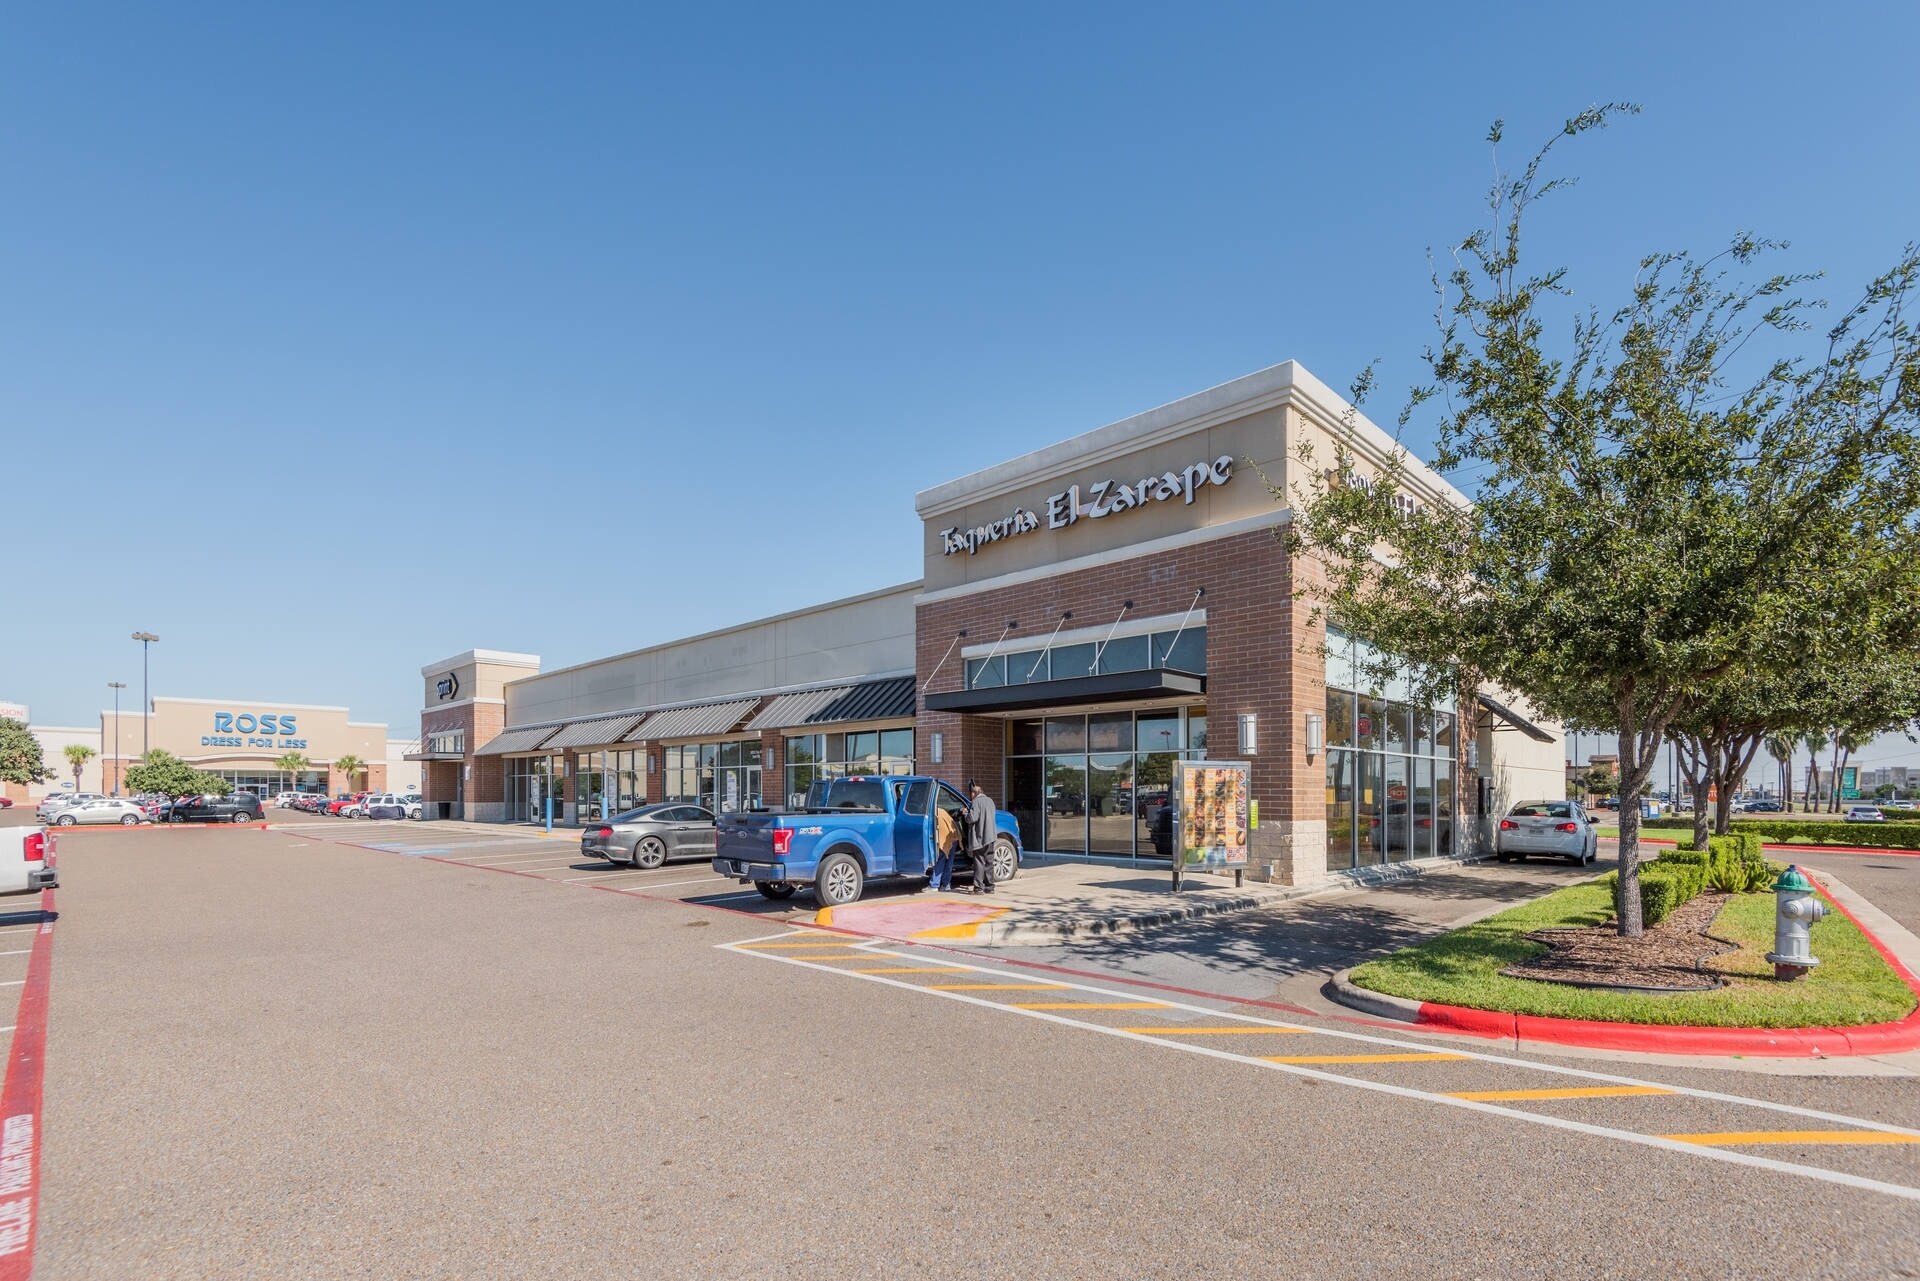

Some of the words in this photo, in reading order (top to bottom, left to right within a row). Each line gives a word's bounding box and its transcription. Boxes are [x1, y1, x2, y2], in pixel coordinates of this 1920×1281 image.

[1046, 484, 1080, 531] El
[1089, 455, 1234, 519] Zarape
[214, 711, 297, 735] ROSS
[201, 735, 242, 747] DRESS
[248, 737, 273, 748] FOR
[277, 738, 307, 749] LESS
